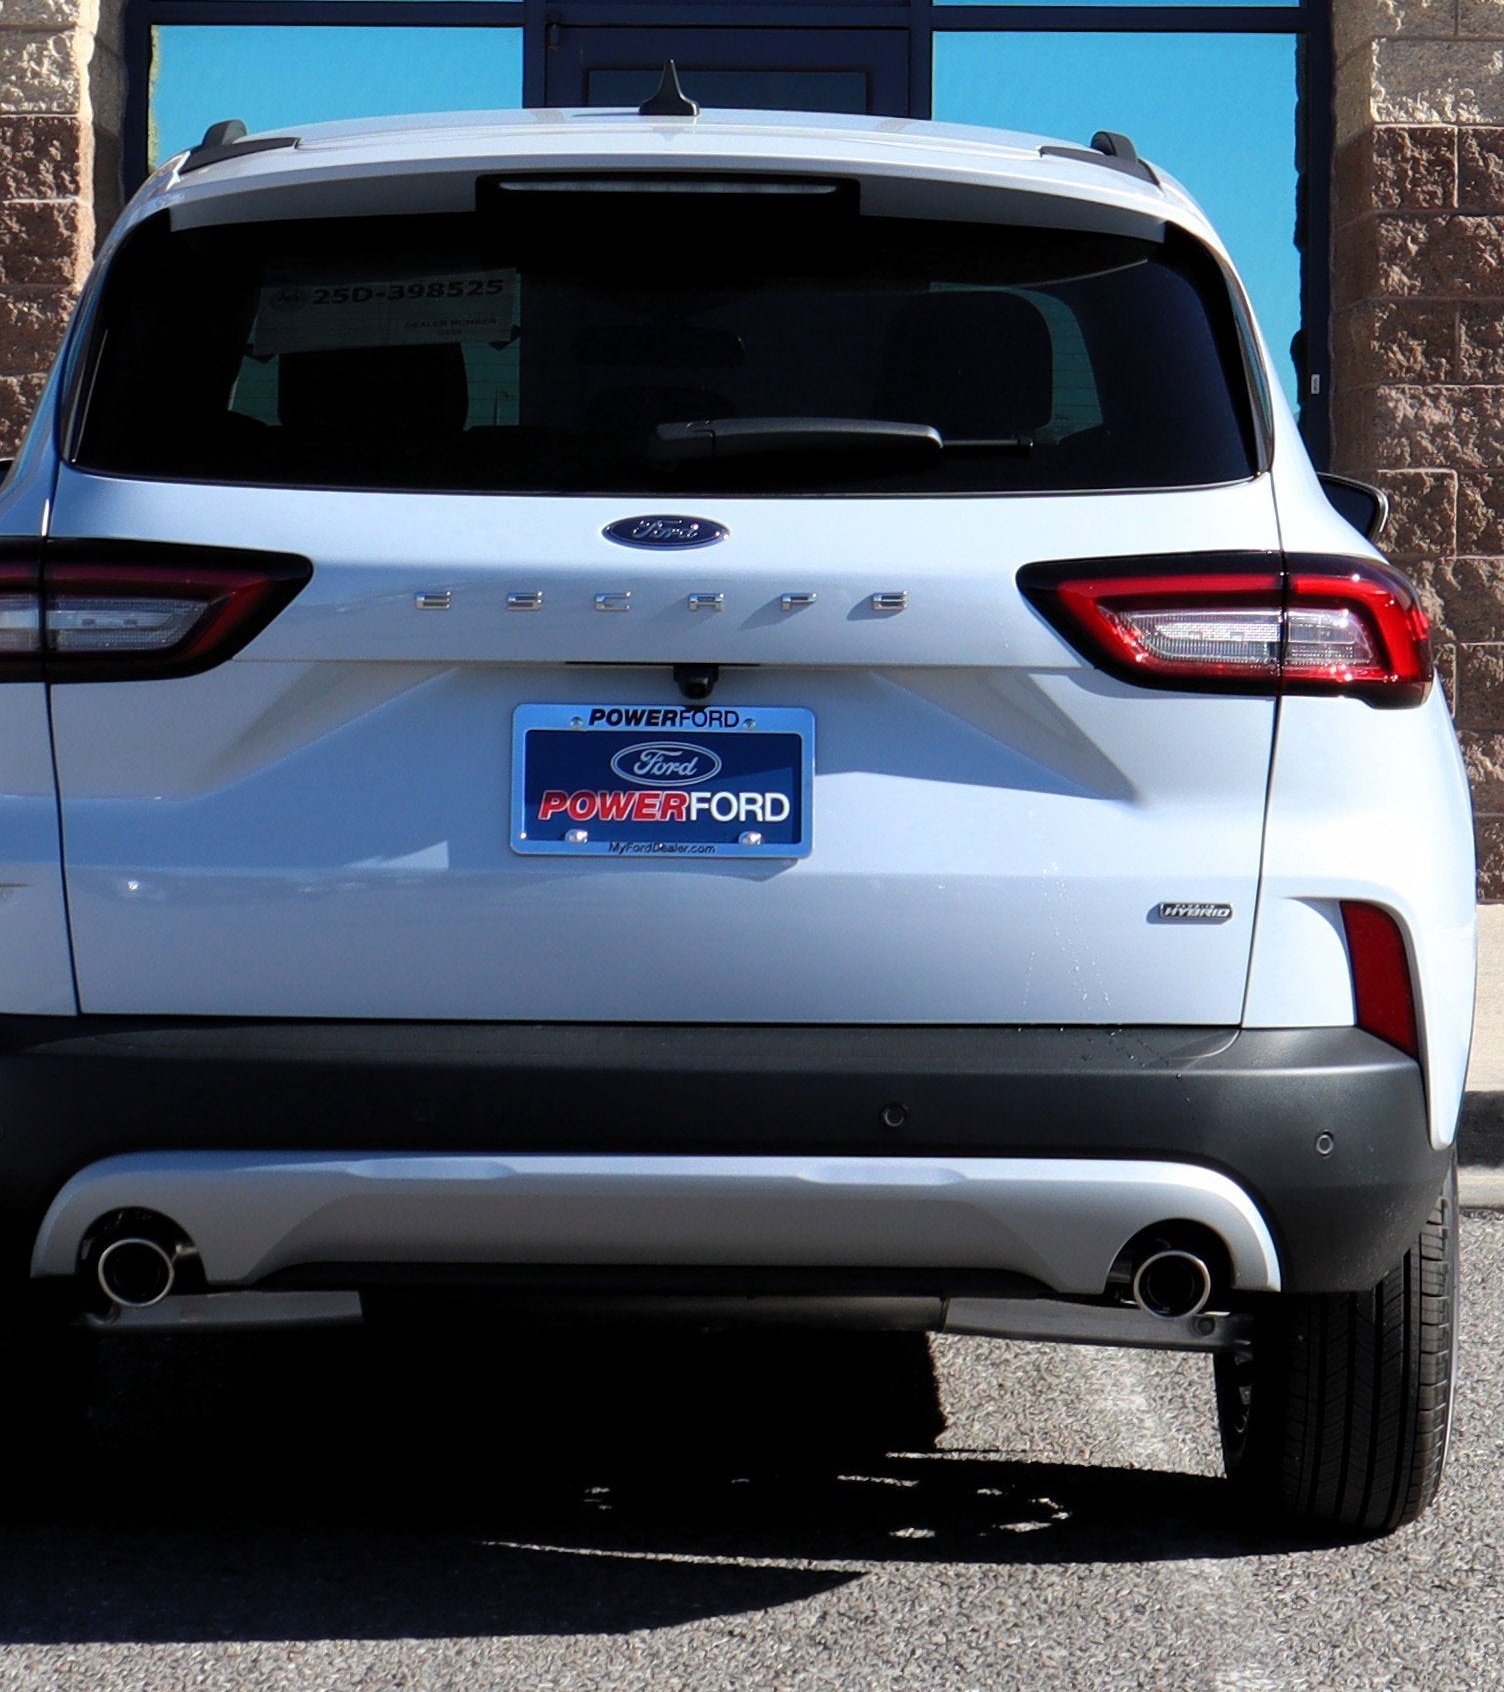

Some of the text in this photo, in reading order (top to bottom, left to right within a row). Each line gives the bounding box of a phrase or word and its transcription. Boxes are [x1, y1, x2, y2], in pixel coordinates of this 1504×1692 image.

[312, 279, 504, 305] 25D-398525
[404, 317, 498, 330] DEALER NUMBER
[631, 519, 701, 540] Ford
[416, 590, 908, 611] ESCAPE
[633, 748, 699, 777] Ford
[539, 790, 790, 822] POWERFORD
[608, 841, 716, 855] MyFordDealer.com
[1164, 908, 1231, 917] HYBRID
